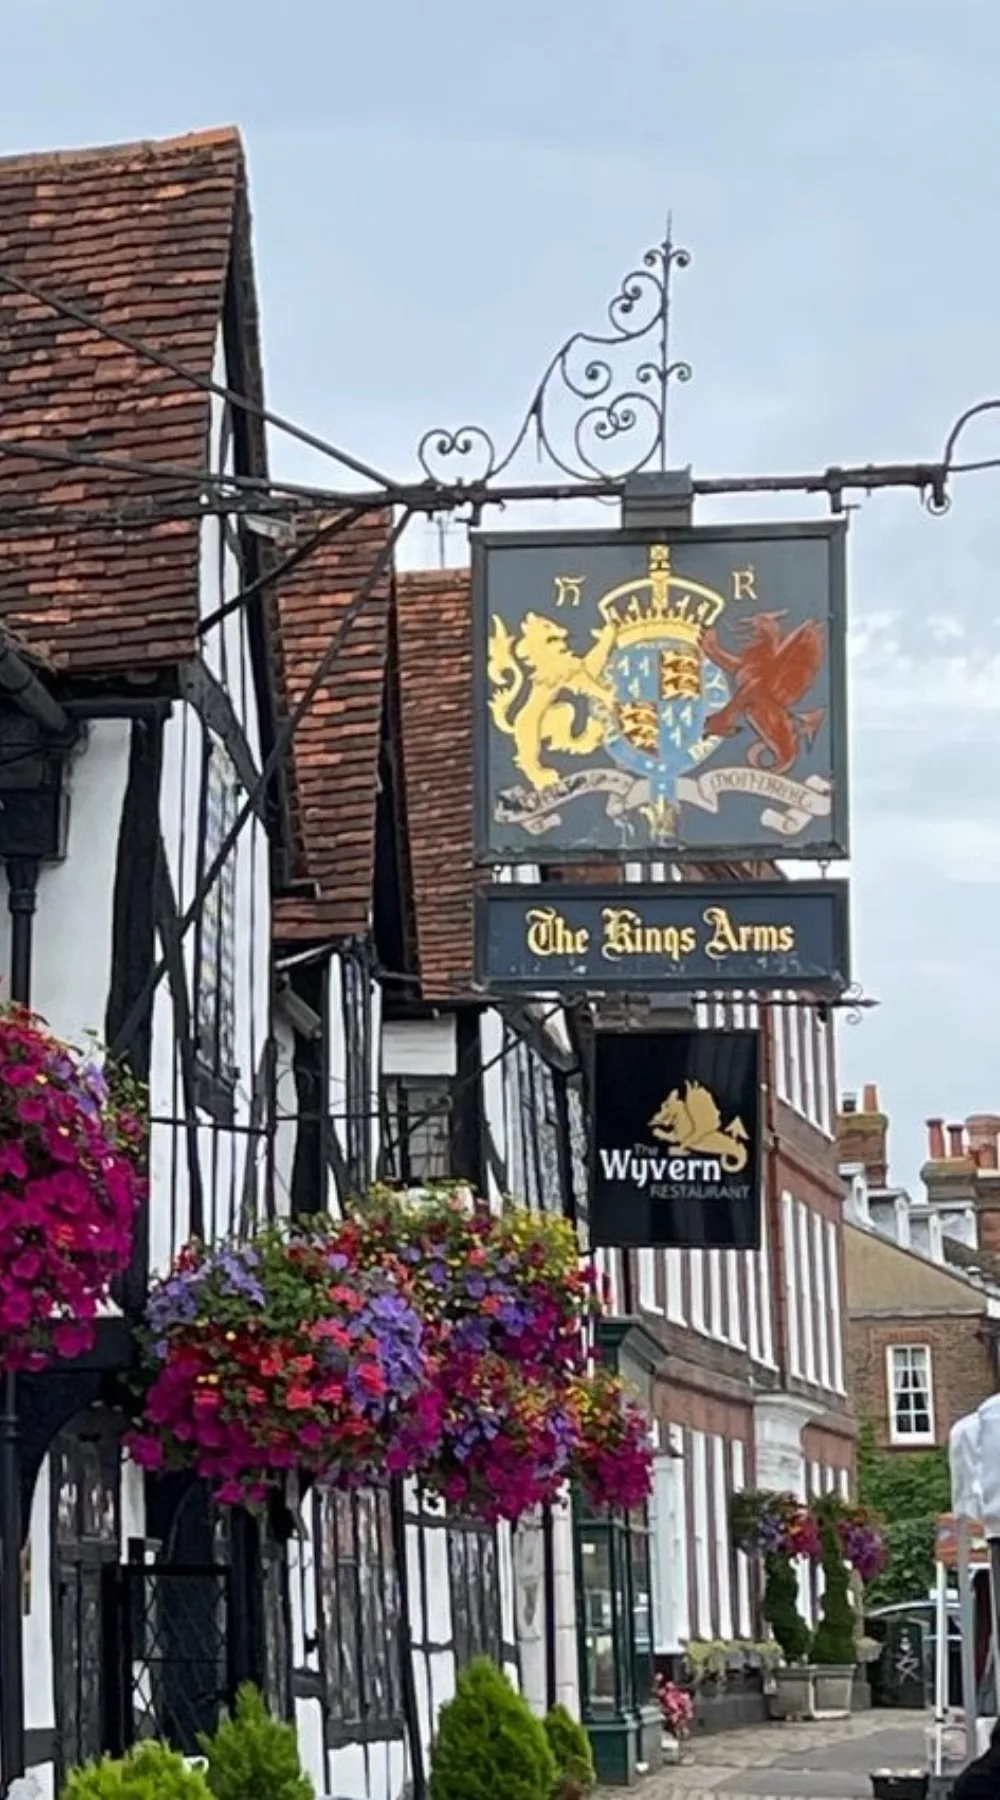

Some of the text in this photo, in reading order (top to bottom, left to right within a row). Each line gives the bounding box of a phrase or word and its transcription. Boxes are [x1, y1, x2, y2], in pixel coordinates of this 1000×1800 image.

[731, 566, 758, 600] R
[526, 907, 795, 961] The Kings Arms
[600, 1149, 722, 1188] Wyvern
[650, 1184, 750, 1199] RESTAURANT
